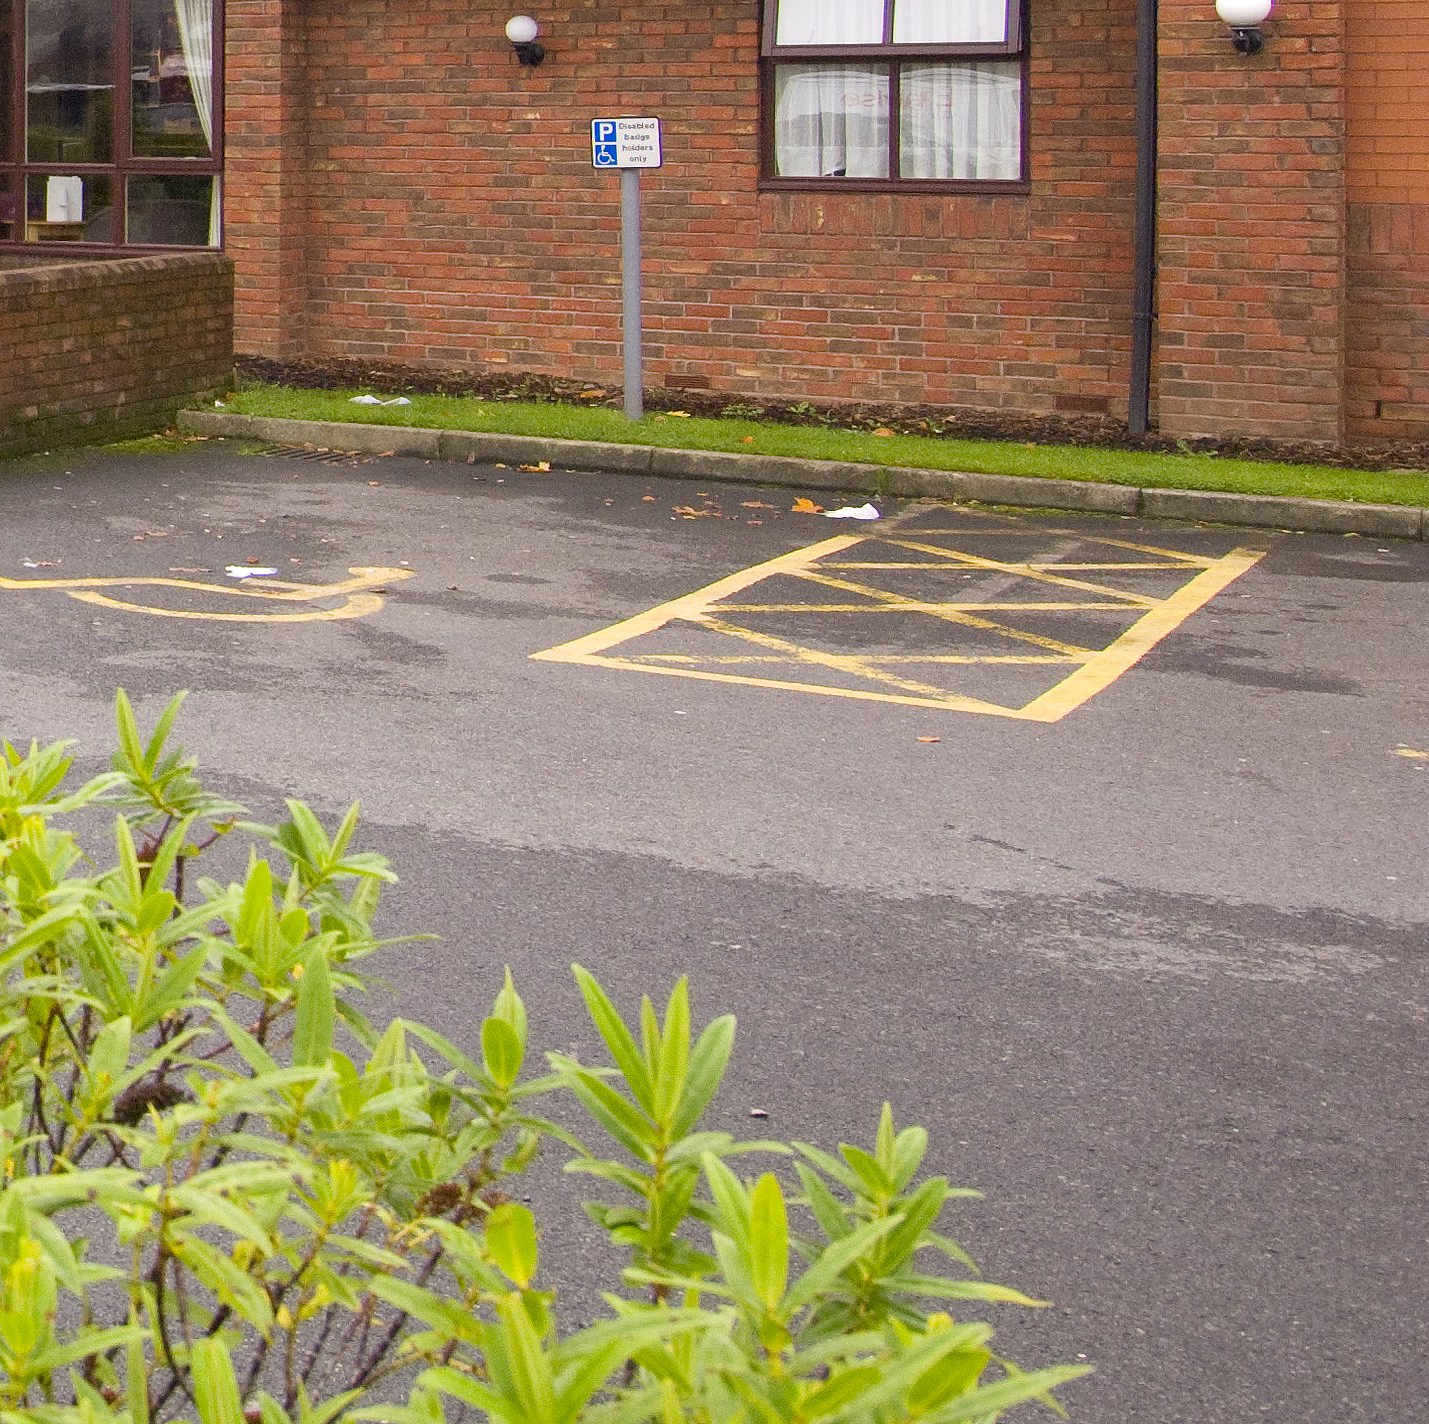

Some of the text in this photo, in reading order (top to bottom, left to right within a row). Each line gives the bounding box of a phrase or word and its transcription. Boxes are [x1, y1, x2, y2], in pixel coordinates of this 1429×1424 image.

[618, 122, 655, 130] Disabled
[599, 123, 614, 141] P
[624, 133, 650, 141] badge
